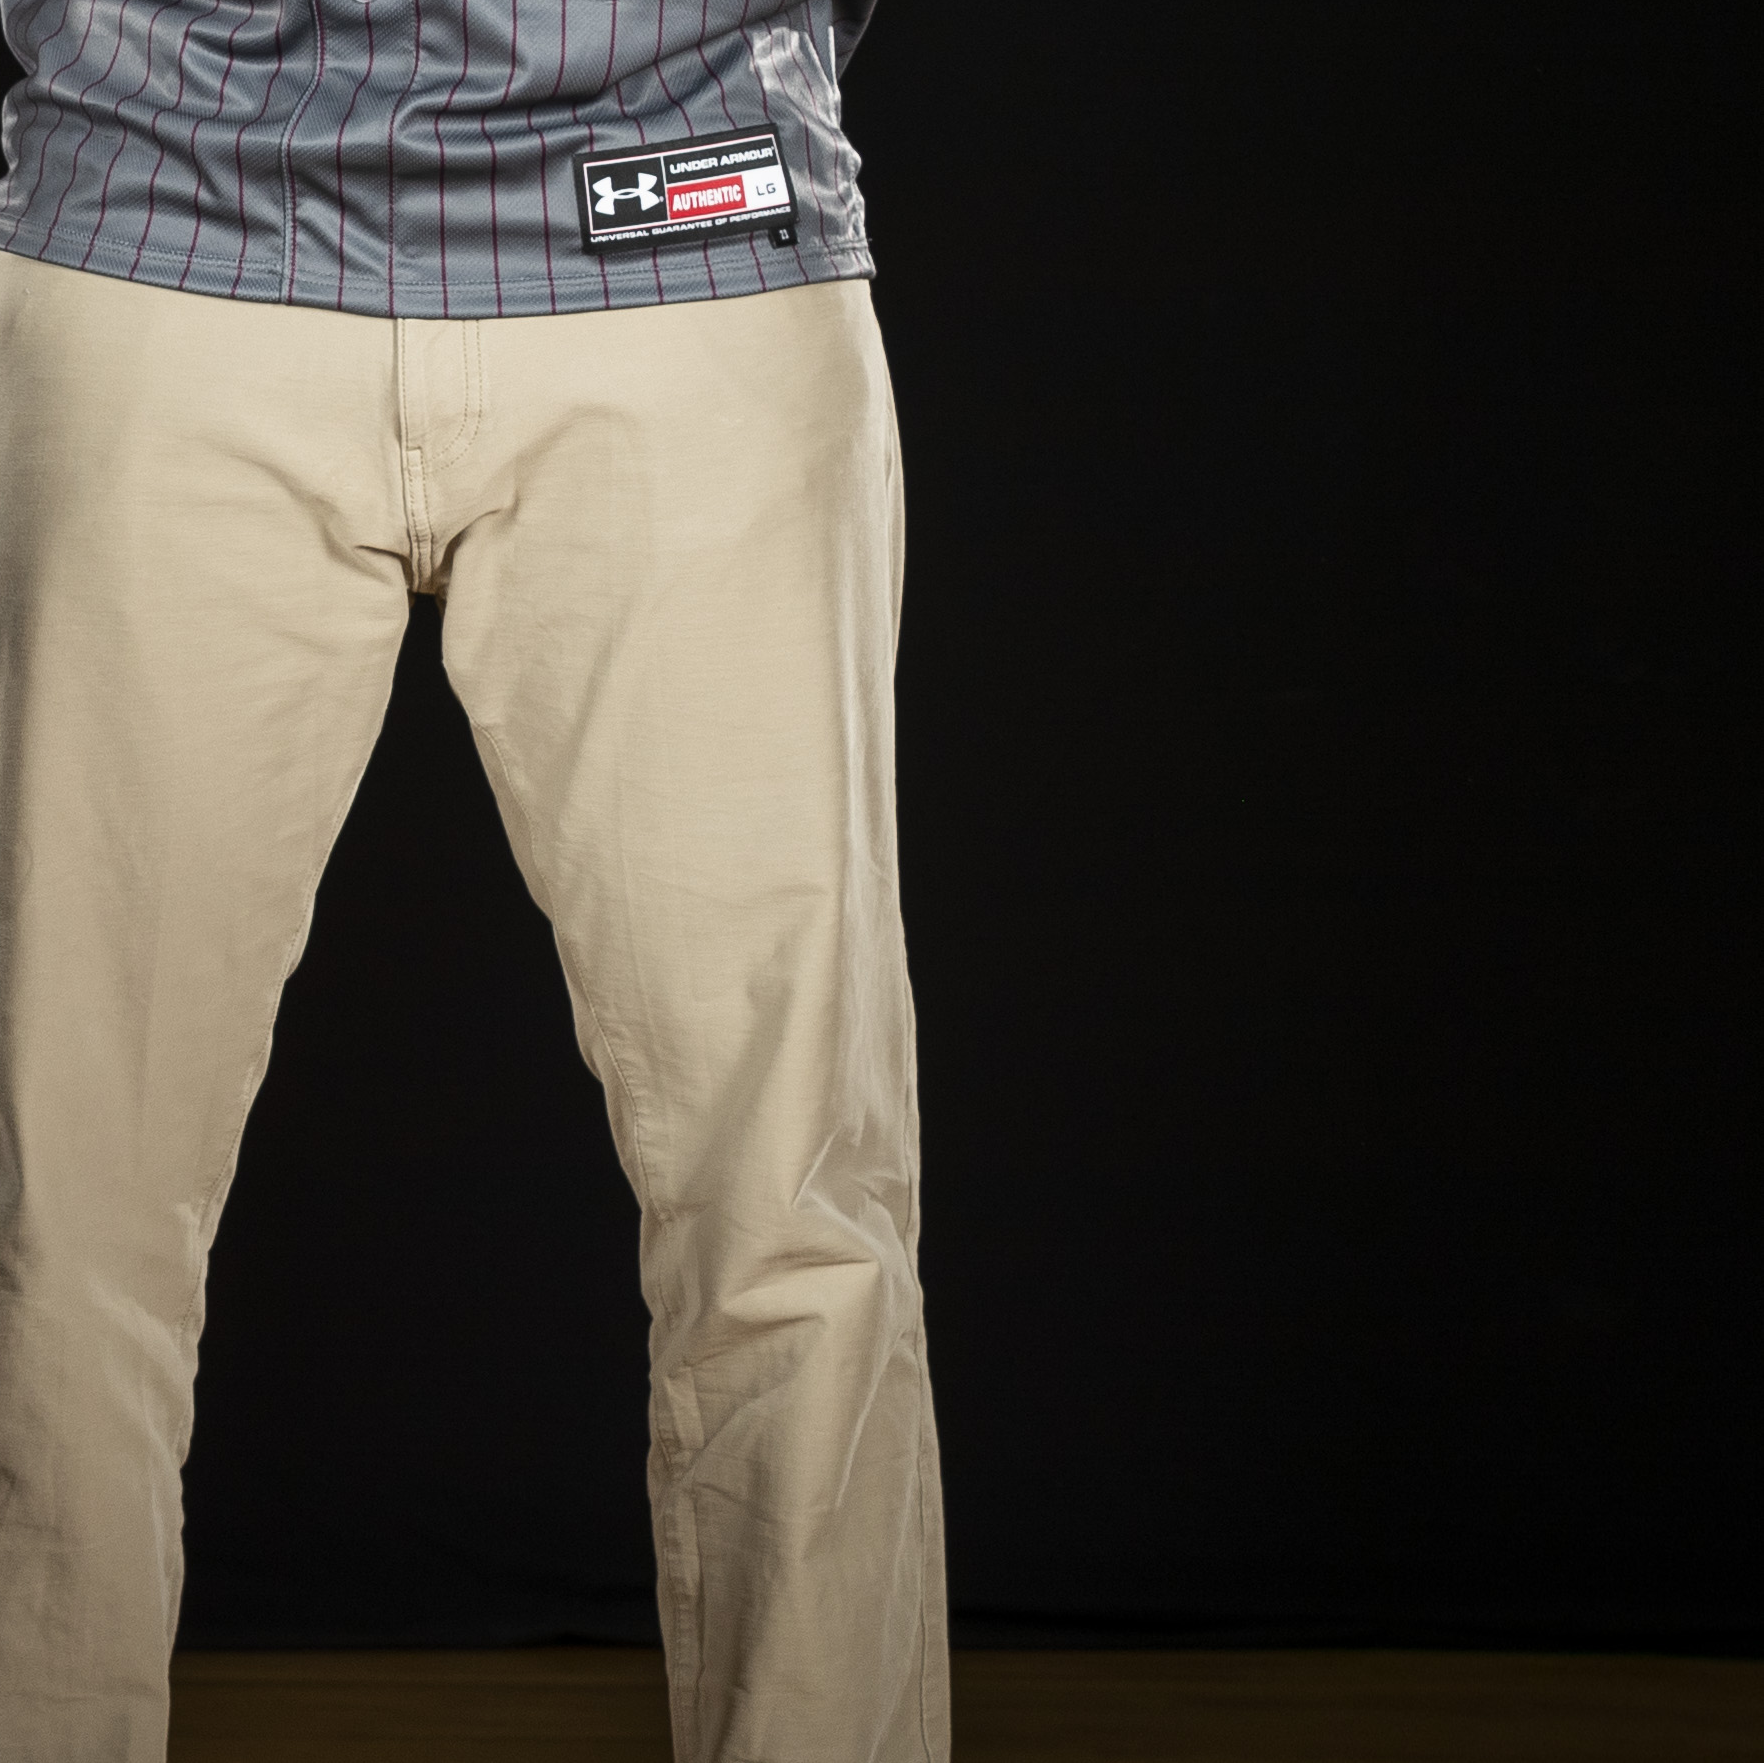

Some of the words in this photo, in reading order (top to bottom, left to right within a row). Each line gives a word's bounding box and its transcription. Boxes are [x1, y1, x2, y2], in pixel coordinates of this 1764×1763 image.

[668, 156, 719, 174] UNDER
[719, 147, 775, 167] ARMOUR
[672, 183, 742, 212] AUTHENTIC
[755, 181, 777, 197] LG
[590, 228, 650, 243] UNIVERSAL
[651, 219, 713, 236] GUARANTEE
[715, 216, 728, 227] OF
[729, 205, 792, 224] PERFORMANCE
